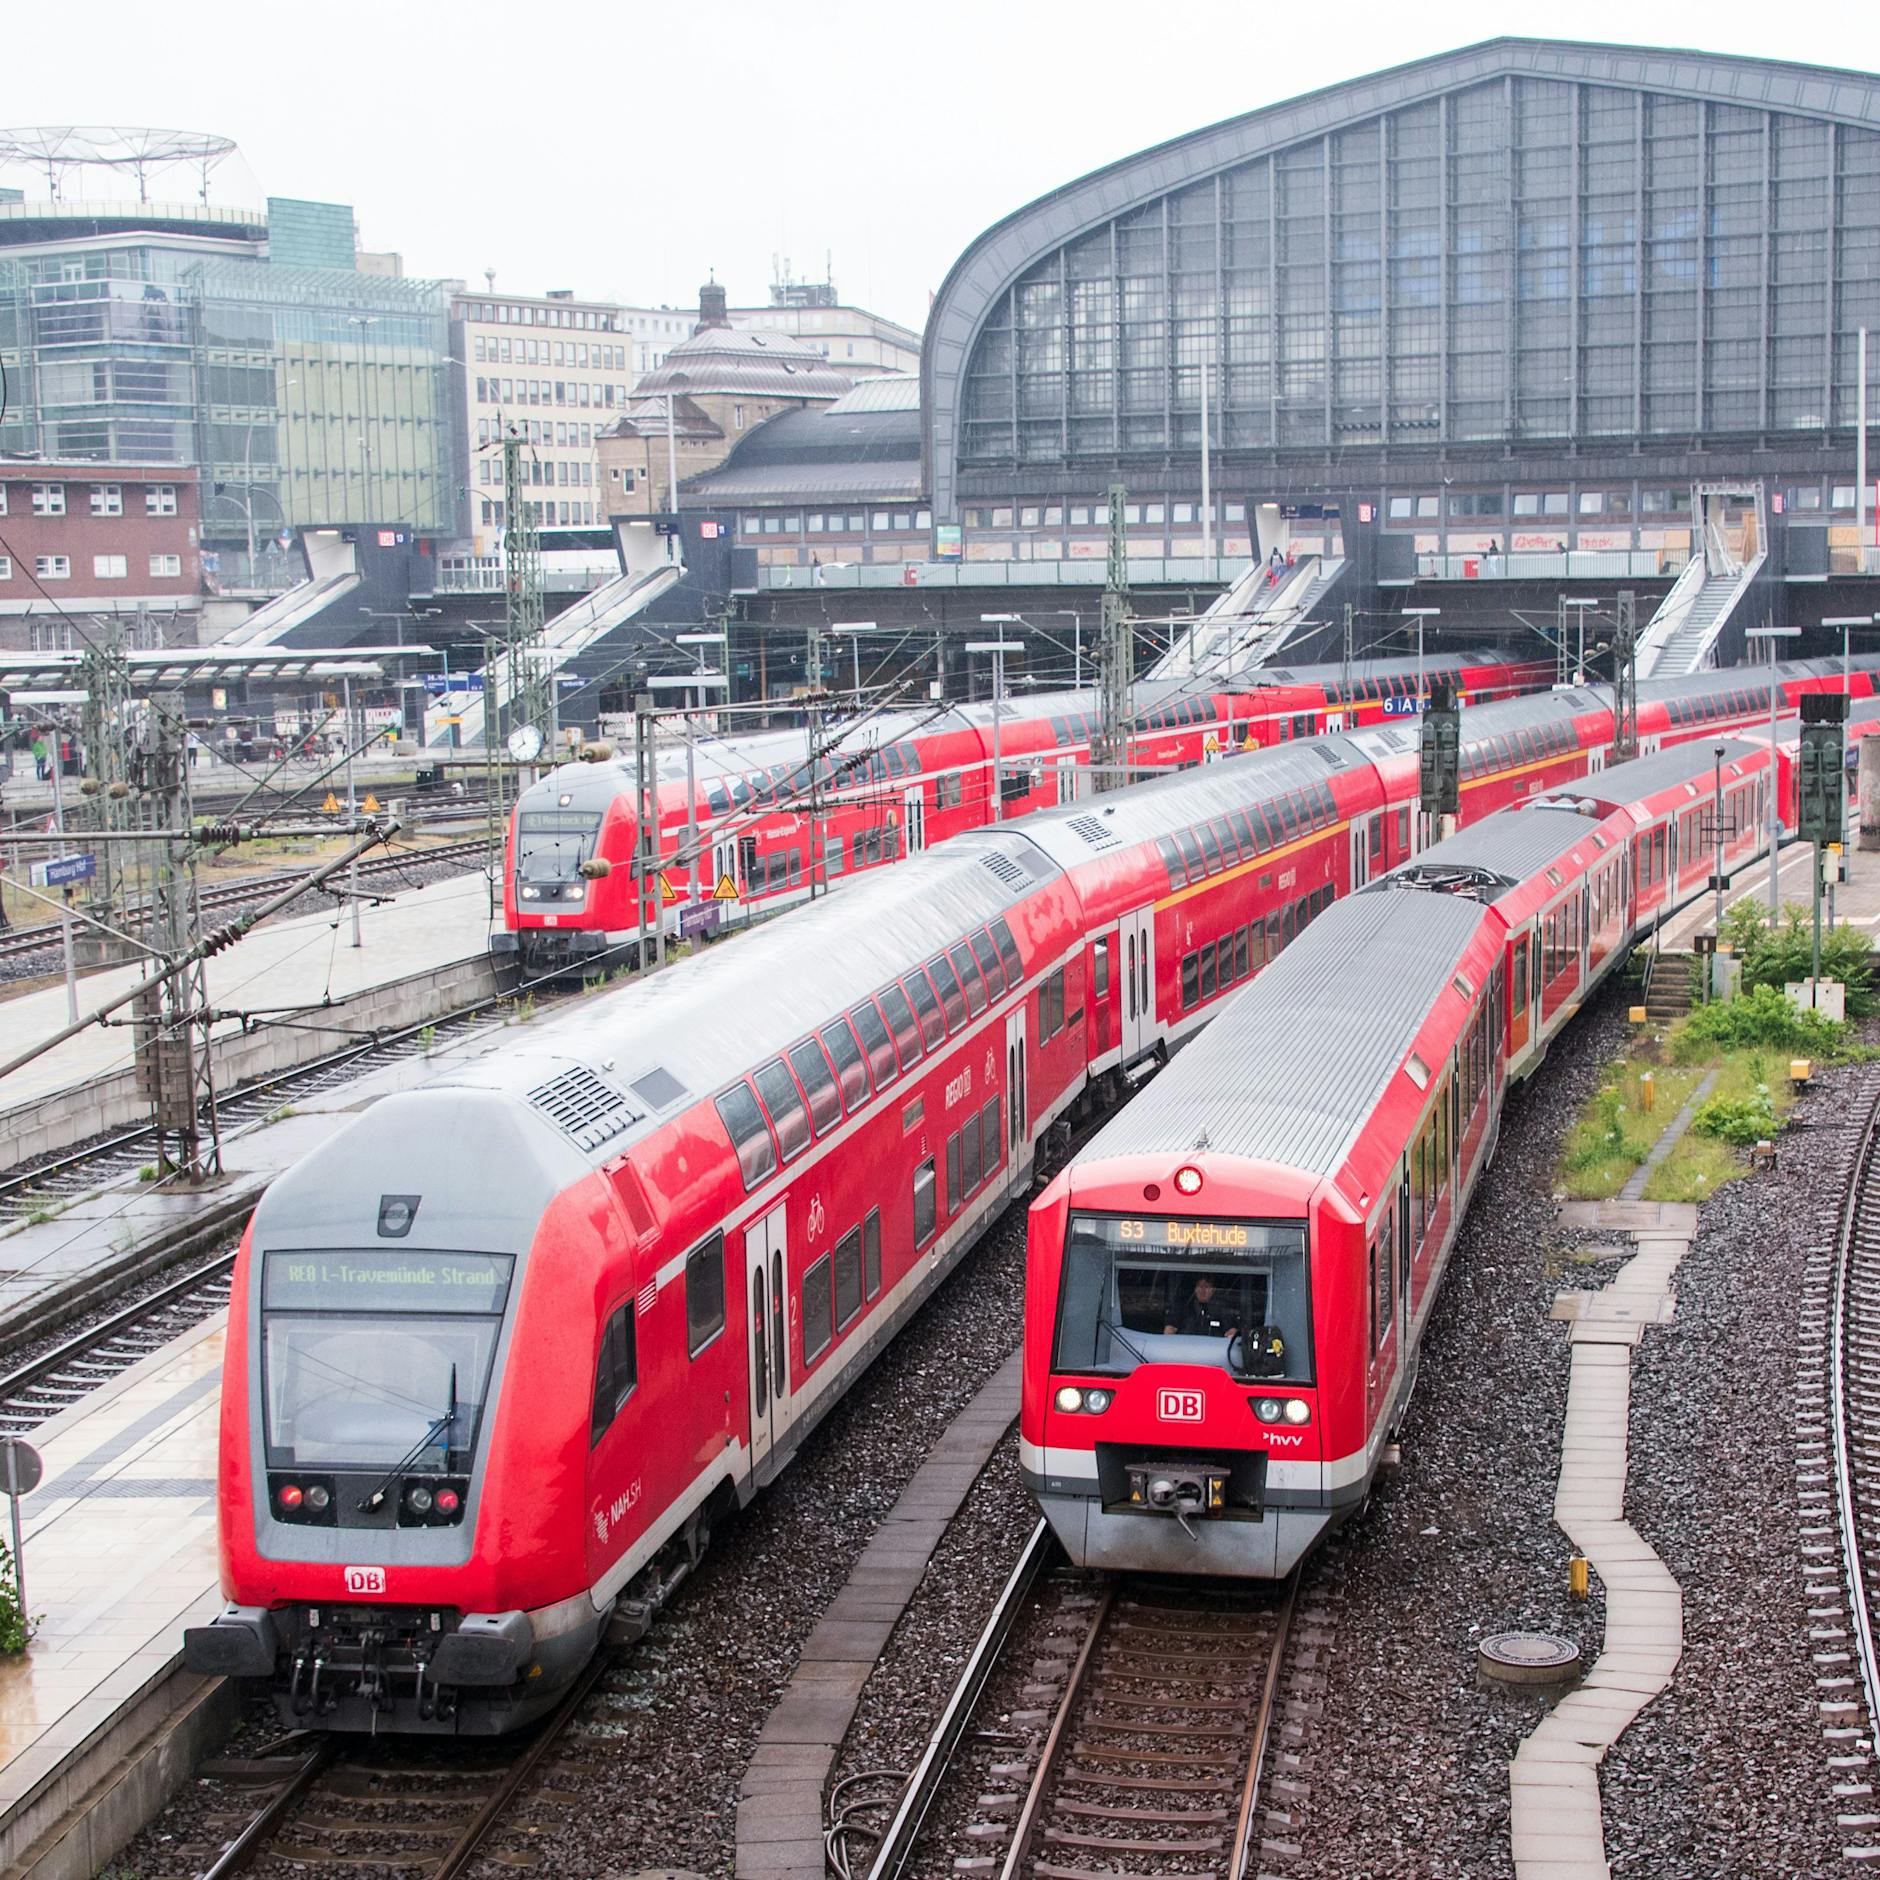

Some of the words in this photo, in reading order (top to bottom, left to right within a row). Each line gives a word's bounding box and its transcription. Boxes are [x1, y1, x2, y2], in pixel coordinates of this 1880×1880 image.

[396, 534, 404, 543] 13
[704, 525, 717, 537] DB
[1384, 697, 1394, 713] 6
[945, 1073, 963, 1111] REGIO
[1120, 1221, 1145, 1239] S3
[1167, 1221, 1248, 1245] Buxtehude
[289, 1265, 316, 1283] RE8
[322, 1266, 436, 1285] L-Travemünde
[441, 1267, 496, 1285] Strand
[790, 1295, 797, 1327] 2
[1162, 1393, 1200, 1418] DB
[1269, 1432, 1303, 1447] hvv
[611, 1477, 642, 1527] NAH.SH
[349, 1570, 382, 1591] DB
